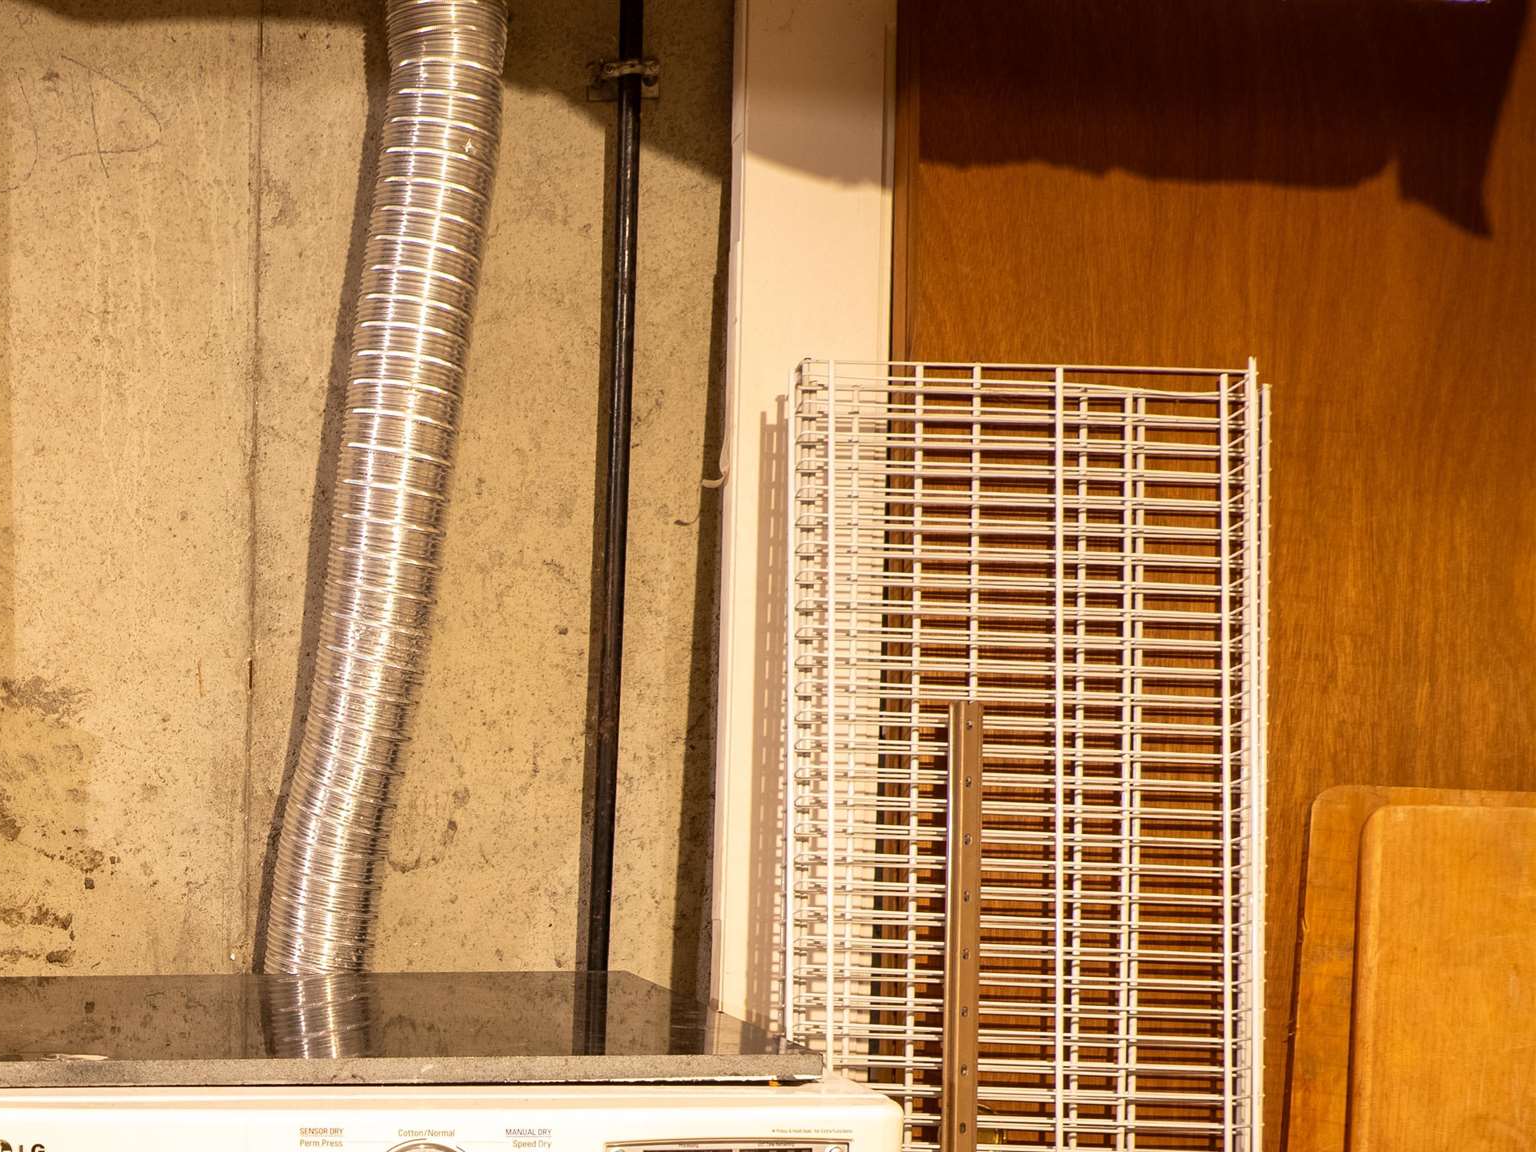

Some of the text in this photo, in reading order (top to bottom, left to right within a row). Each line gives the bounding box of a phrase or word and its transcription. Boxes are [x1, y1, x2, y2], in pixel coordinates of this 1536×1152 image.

[299, 1127, 344, 1136] SENSOR DRY
[398, 1128, 455, 1137] Cotton/Normal
[505, 1128, 552, 1136] MANUAL DRY
[299, 1139, 344, 1147] Perm Press
[512, 1139, 552, 1149] Speed Dry
